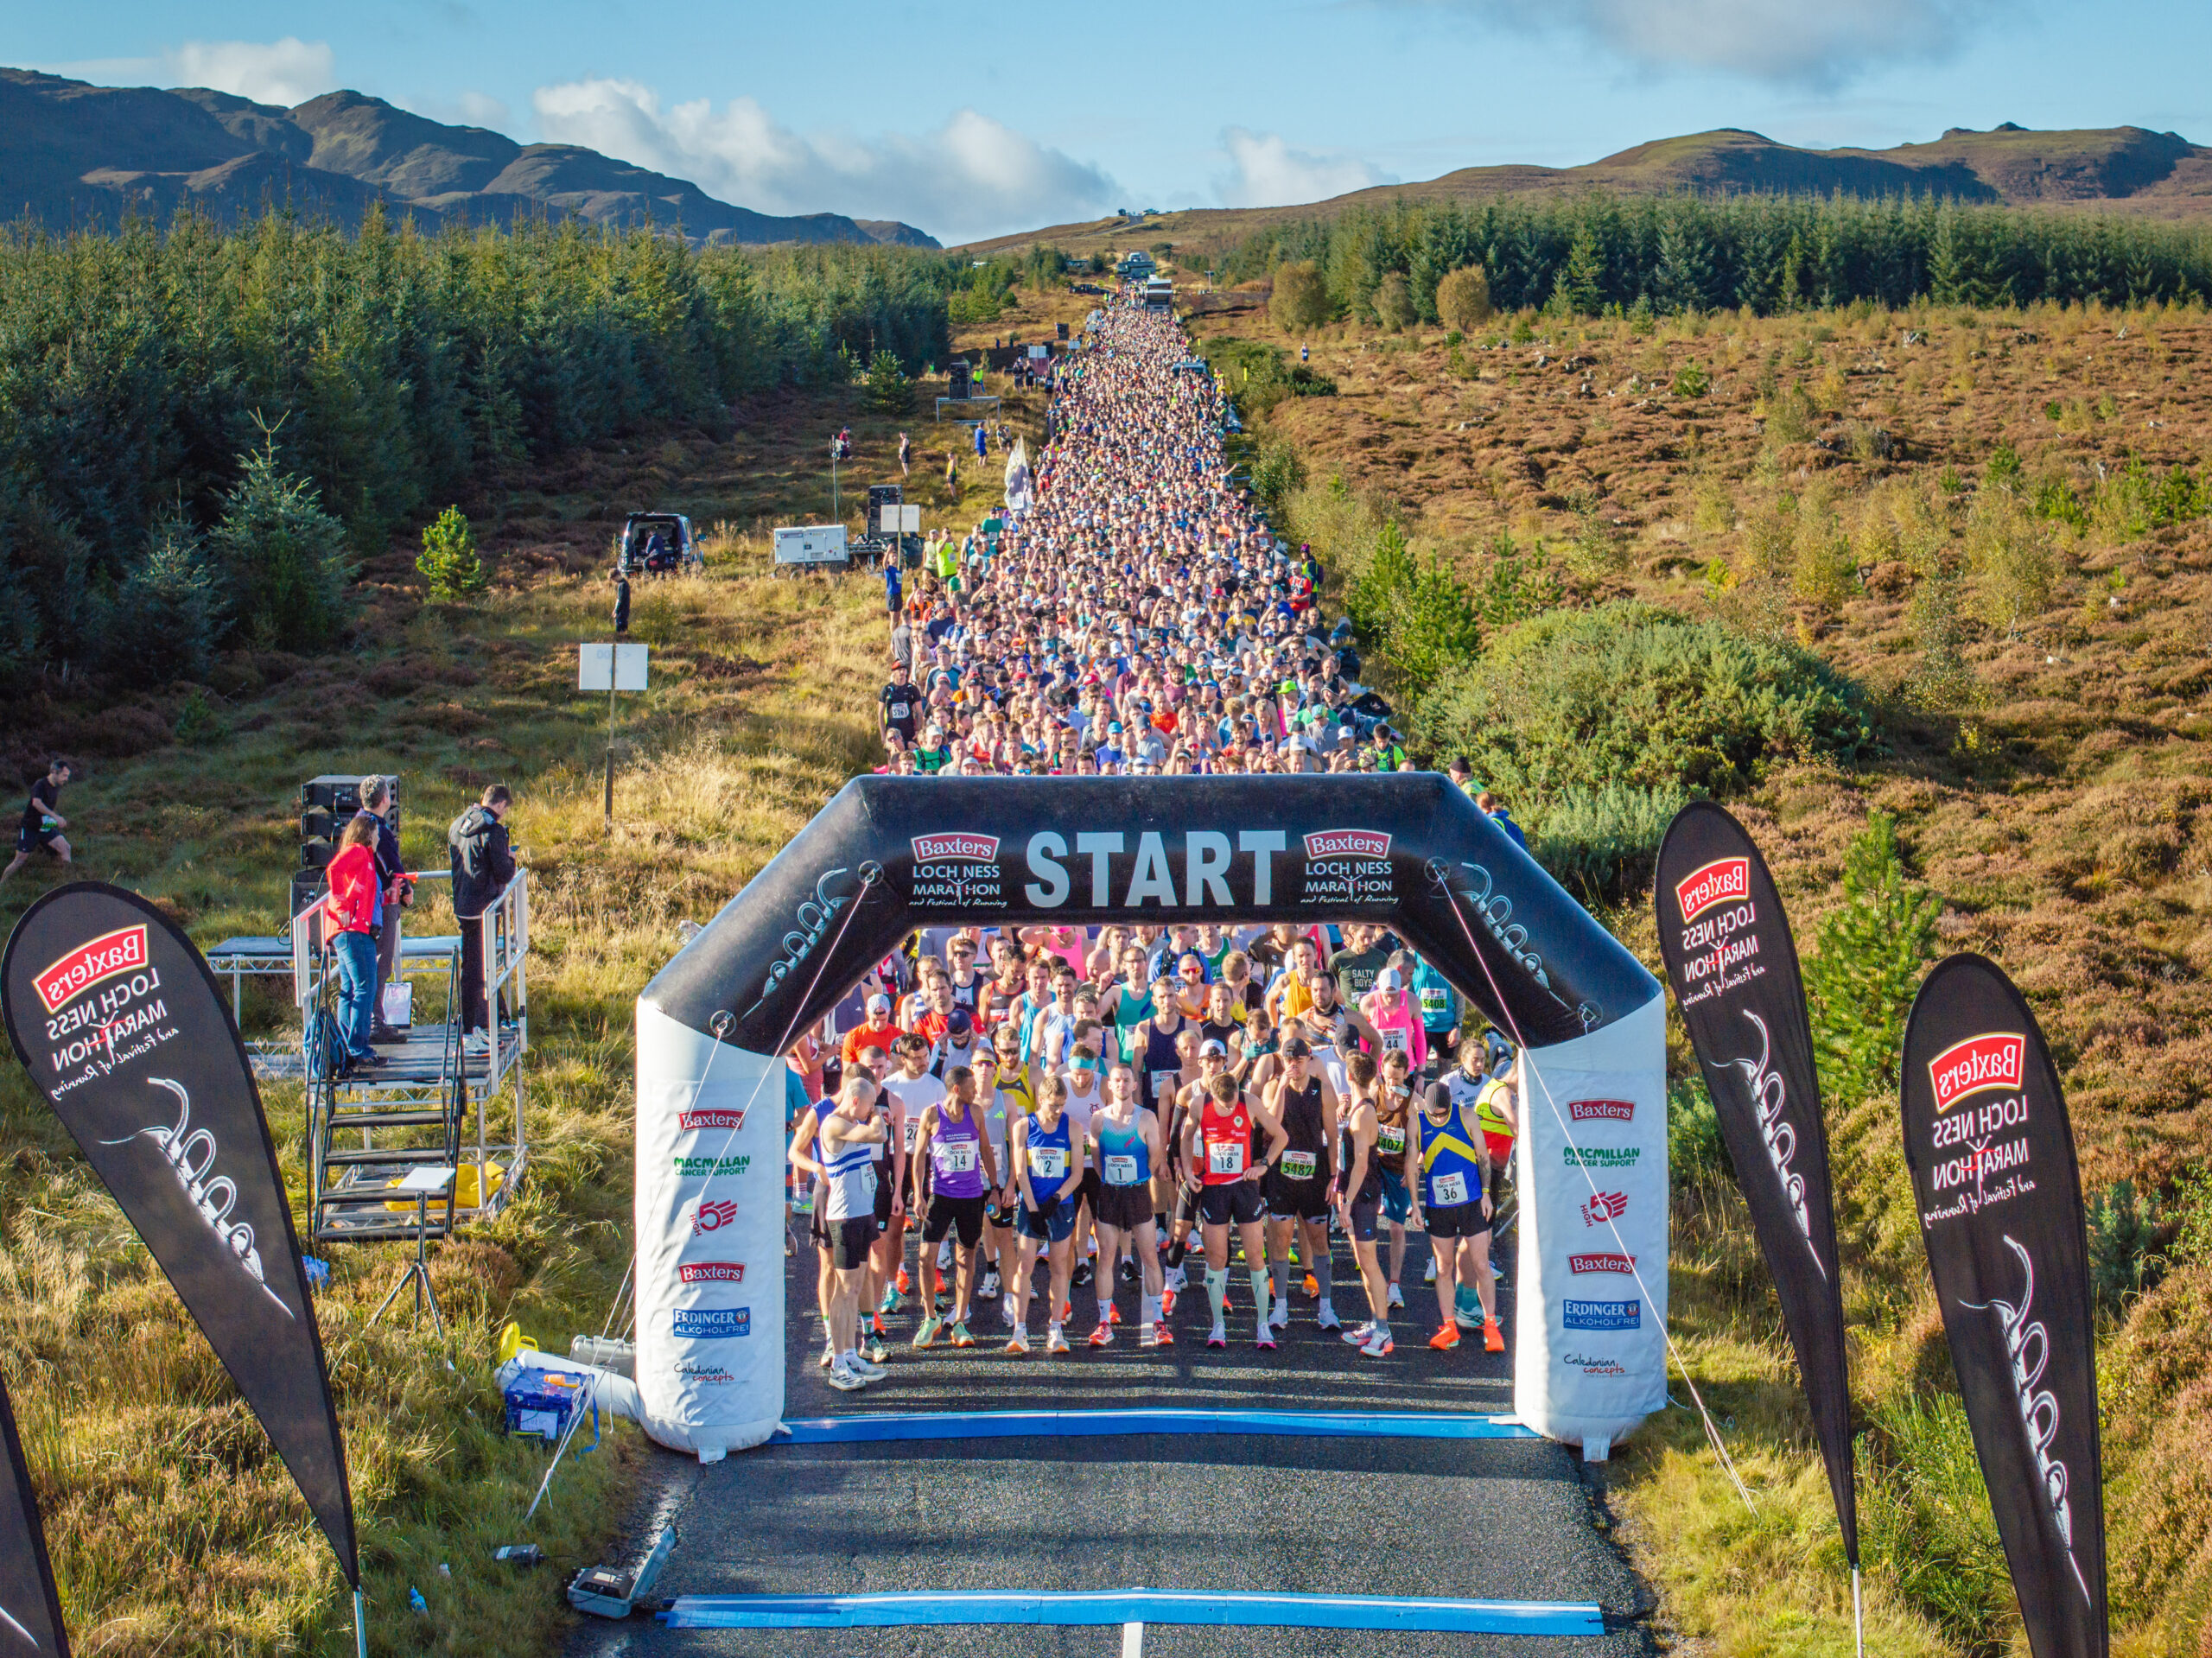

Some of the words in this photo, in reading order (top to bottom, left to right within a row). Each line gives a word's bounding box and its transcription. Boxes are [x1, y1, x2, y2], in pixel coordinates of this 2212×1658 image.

[918, 837, 993, 857] Baxters
[1311, 834, 1384, 854] Baxters
[912, 865, 958, 879] LOCH
[963, 865, 1000, 878] NESS
[1025, 830, 1287, 908] START
[1306, 862, 1351, 875] LOCH
[1355, 861, 1393, 874] NESS
[912, 881, 1001, 897] MARATHON
[1305, 878, 1393, 893] MARATHON
[926, 898, 957, 906] Festival
[962, 899, 972, 908] of
[972, 898, 1007, 908] Running
[1300, 895, 1316, 904] and
[1319, 894, 1349, 904] Festival
[1353, 895, 1363, 905] of
[1364, 894, 1400, 905] Running
[1351, 969, 1375, 978] SALTY
[1354, 978, 1374, 988] BOYS
[1423, 999, 1446, 1009] 5408
[1386, 1039, 1399, 1051] 44
[1573, 1102, 1631, 1119] Baxters
[681, 1112, 741, 1128] Baxters
[1380, 1138, 1402, 1151] 407
[1563, 1147, 1640, 1159] MACMILLAN
[674, 1155, 750, 1168] MACMILLAN
[954, 1155, 967, 1166] 14
[1045, 1160, 1052, 1172] 2
[1220, 1157, 1234, 1169] 18
[1599, 1159, 1637, 1167] SUPPORT
[1118, 1168, 1122, 1180] 1
[1283, 1162, 1313, 1177] 5482
[1443, 1187, 1458, 1200] 36
[1580, 1204, 1593, 1228] HIGH
[689, 1213, 702, 1237] HIGH
[1573, 1256, 1633, 1273] Baxters
[683, 1266, 741, 1280] Baxters
[1565, 1301, 1626, 1316] ERDINGER
[674, 1310, 735, 1324] ERDINGER
[1565, 1317, 1639, 1325] ALKOHOLFREI
[674, 1324, 749, 1334] ALKOHOLFREI
[1563, 1353, 1616, 1367] Caledonian
[674, 1363, 724, 1375] Caledonian
[1583, 1363, 1625, 1377] concepts
[692, 1371, 734, 1385] concepts
